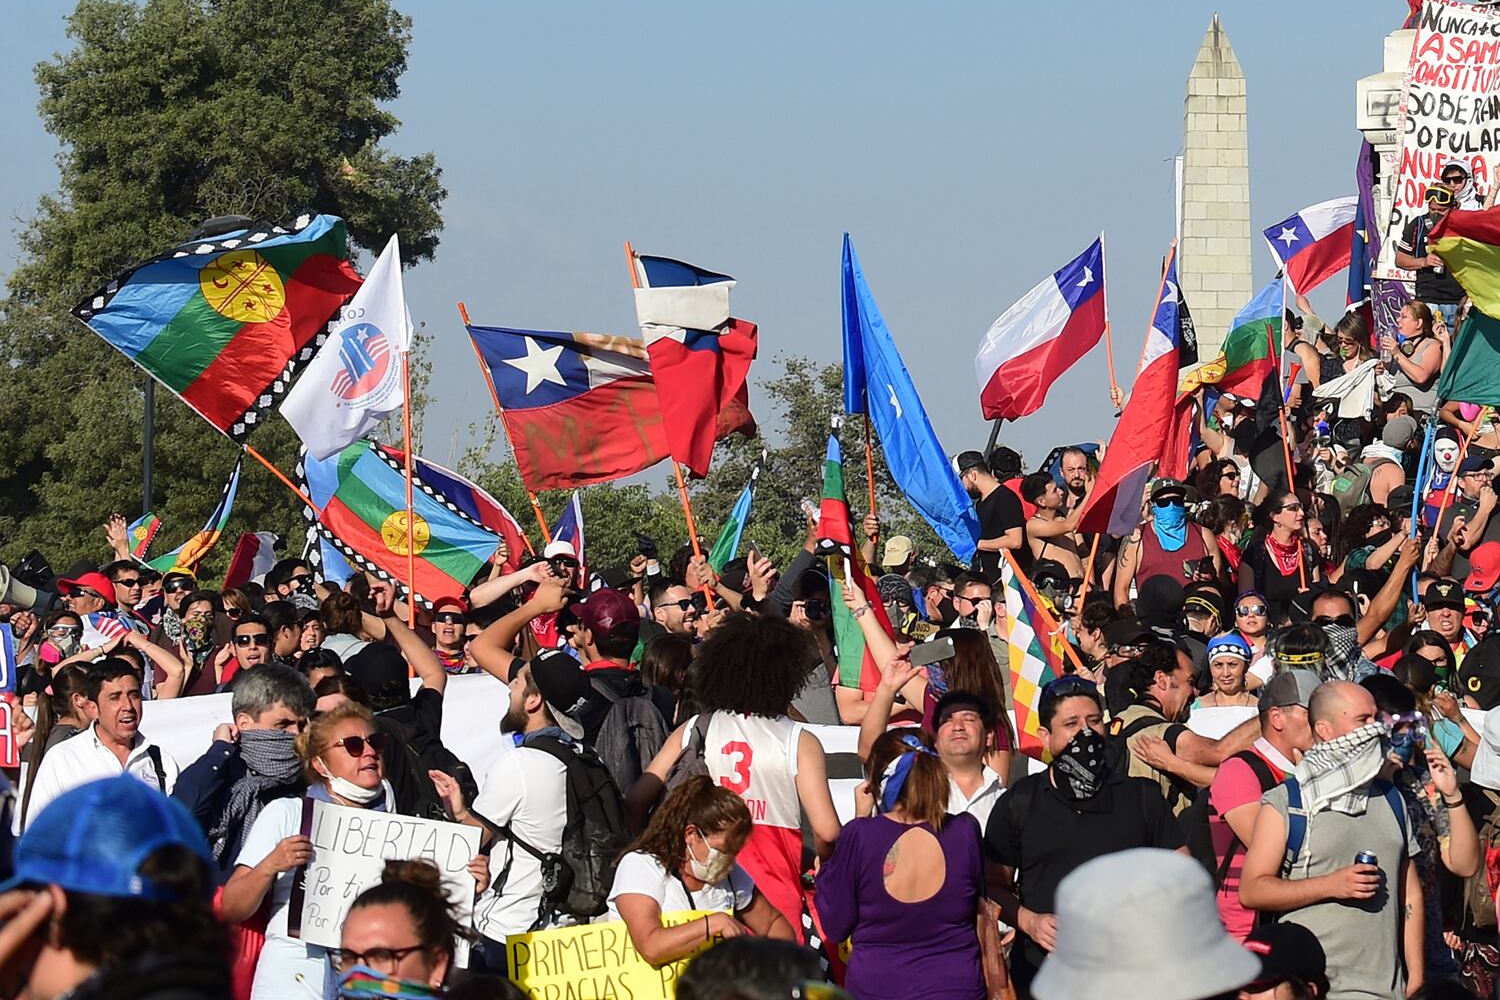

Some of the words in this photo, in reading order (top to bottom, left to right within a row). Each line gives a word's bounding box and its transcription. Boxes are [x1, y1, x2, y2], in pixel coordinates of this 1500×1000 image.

[1421, 3, 1476, 36] NUNCA
[1400, 146, 1488, 183] NUEA
[720, 740, 753, 796] 3
[314, 810, 472, 873] LIBERTAD
[312, 866, 334, 896] Por
[307, 902, 329, 929] Por
